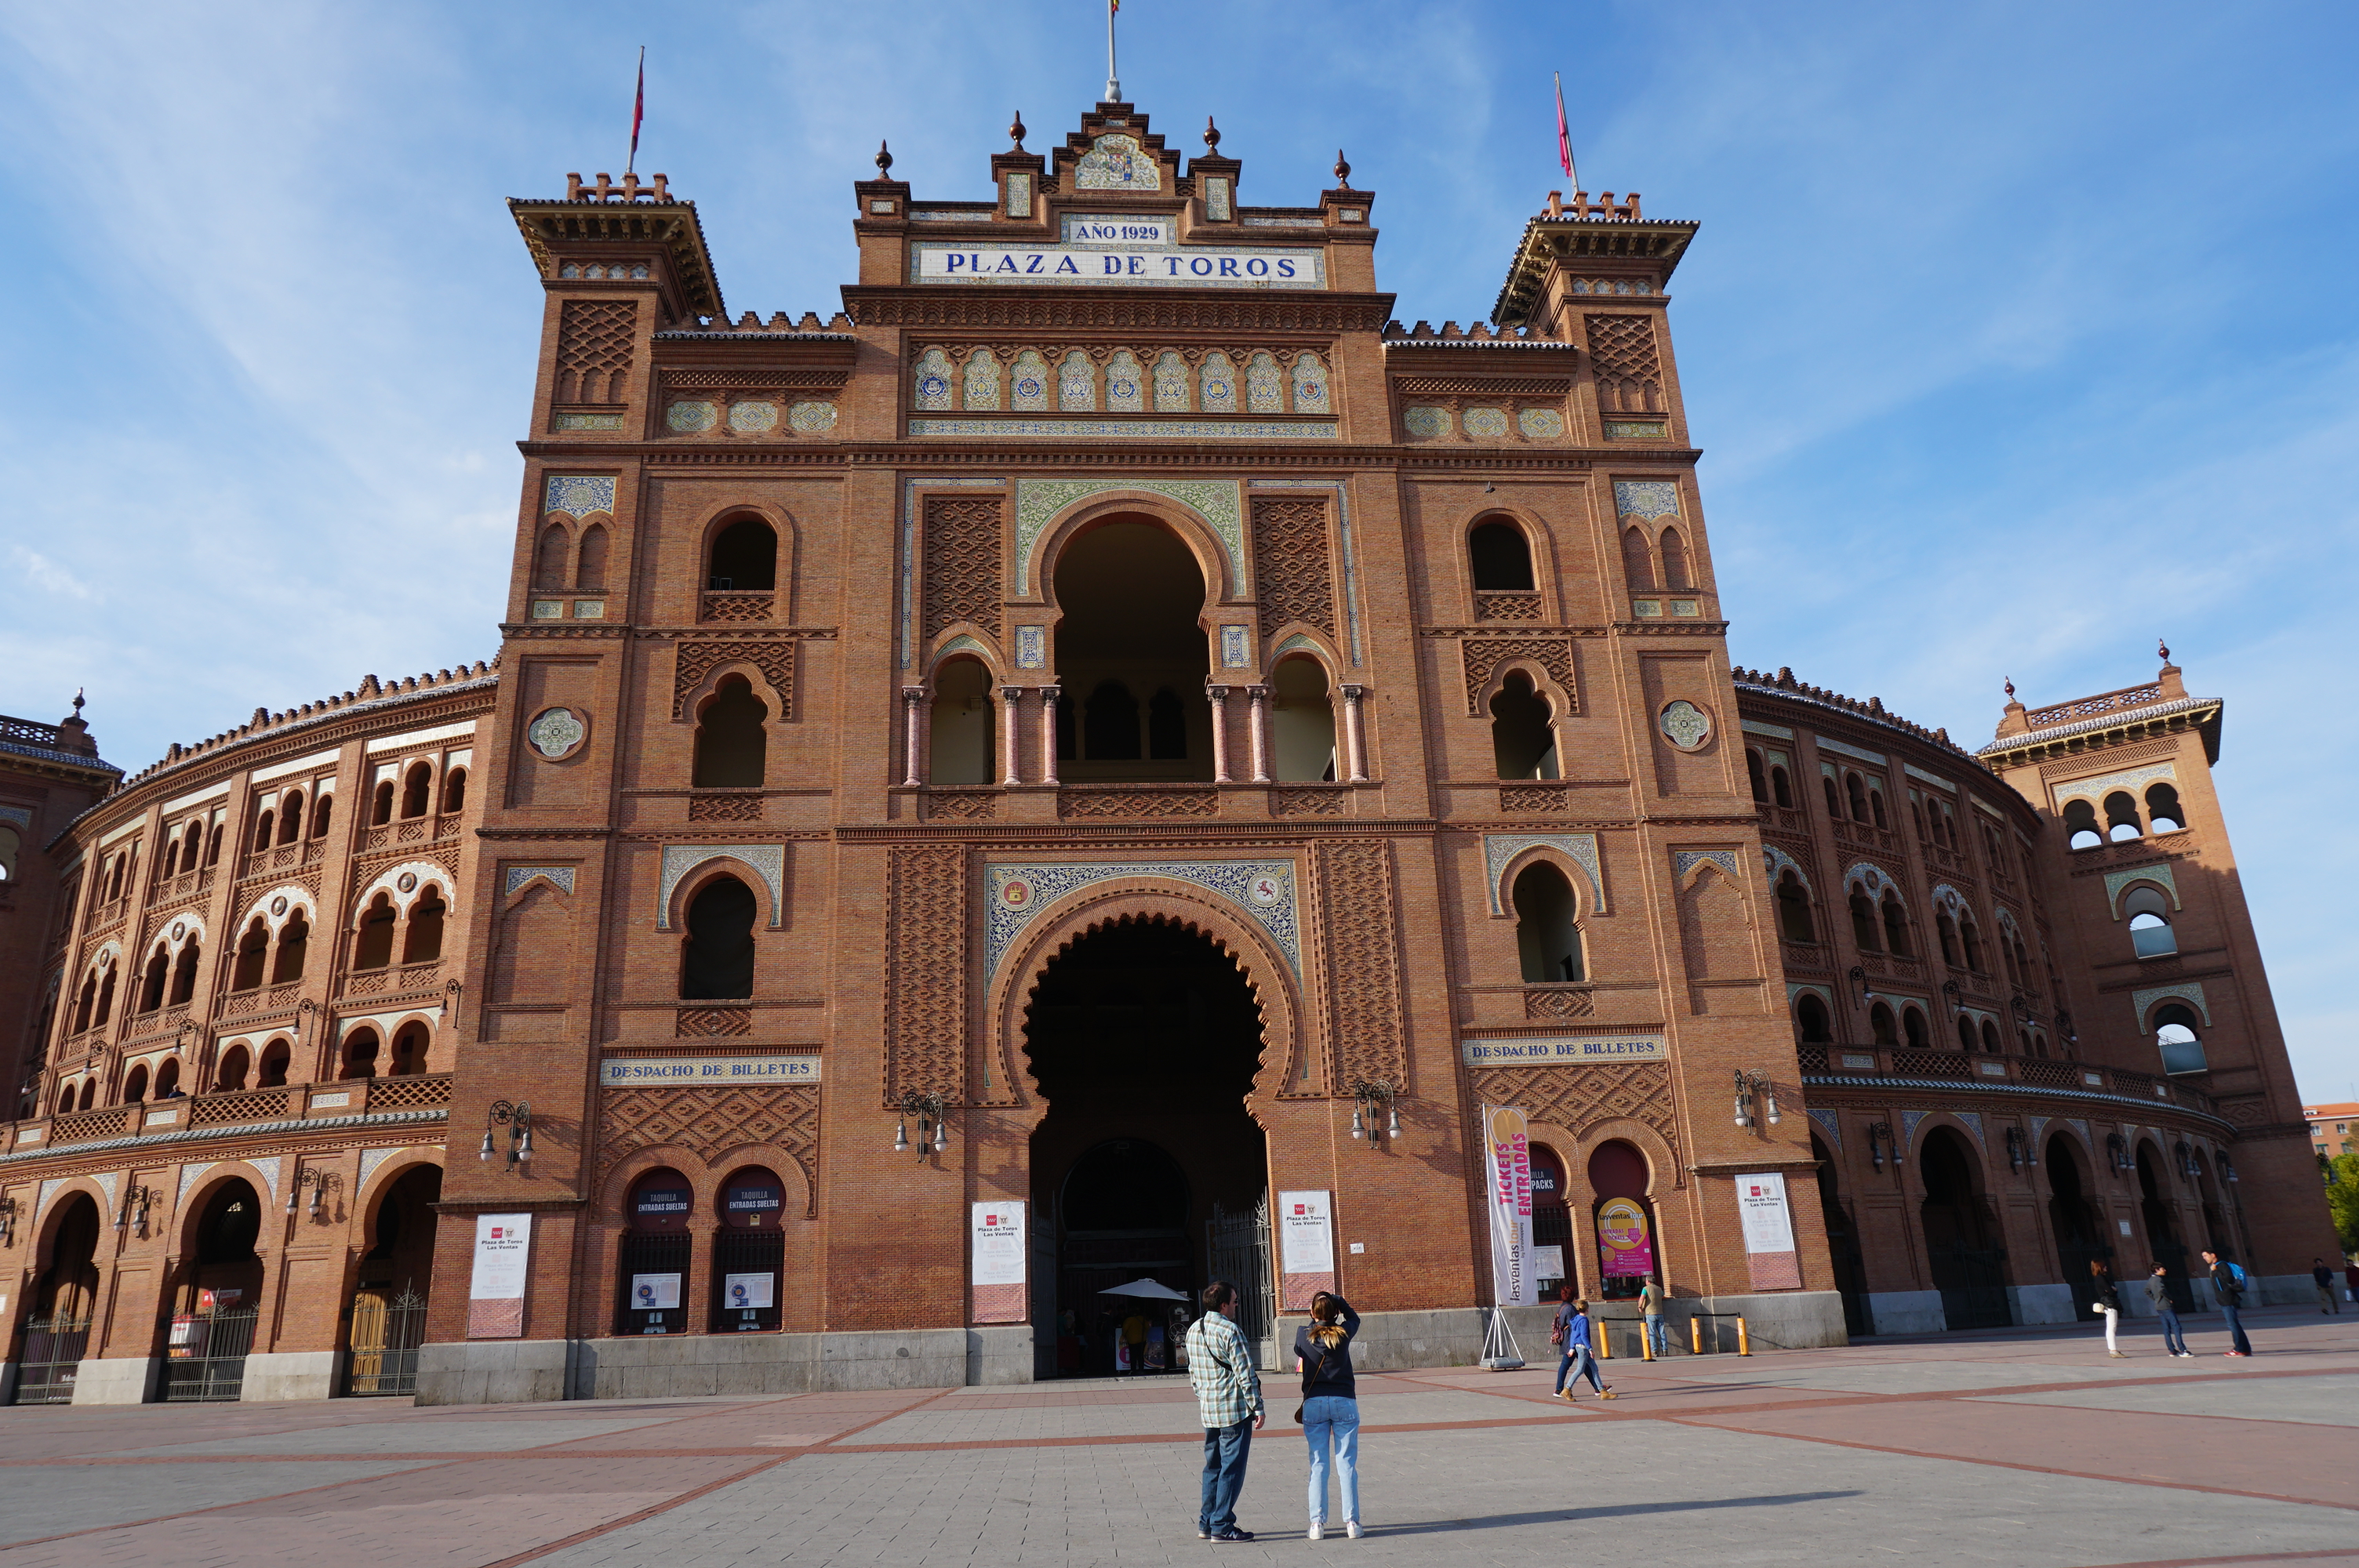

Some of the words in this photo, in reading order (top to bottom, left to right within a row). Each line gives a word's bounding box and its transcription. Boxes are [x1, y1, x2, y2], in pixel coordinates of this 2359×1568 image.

[1076, 223, 1116, 239] AÑO
[1121, 226, 1159, 240] 1929
[945, 253, 1081, 274] PLAZA
[1103, 256, 1146, 274] DE
[1162, 256, 1296, 278] TOROS
[1471, 1045, 1549, 1058] DESPACHO
[1556, 1044, 1576, 1054] DE
[1583, 1041, 1655, 1054] BILLETES
[610, 1065, 693, 1078] DESPACHO
[702, 1065, 723, 1076] DE
[731, 1063, 809, 1076] BILLETES
[1496, 1143, 1513, 1205] TICKETS
[1511, 1133, 1532, 1216] ENTRADAS
[1532, 1179, 1554, 1189] PACKS
[650, 1193, 677, 1202] TAQUILLA
[741, 1191, 768, 1200] TAQUILLA
[638, 1203, 664, 1211] ENTRADAS
[666, 1202, 687, 1210] SUELTAS
[729, 1200, 756, 1209] ENTRADAS
[757, 1200, 779, 1208] SUELTAS
[1509, 1219, 1521, 1301] lasventastour
